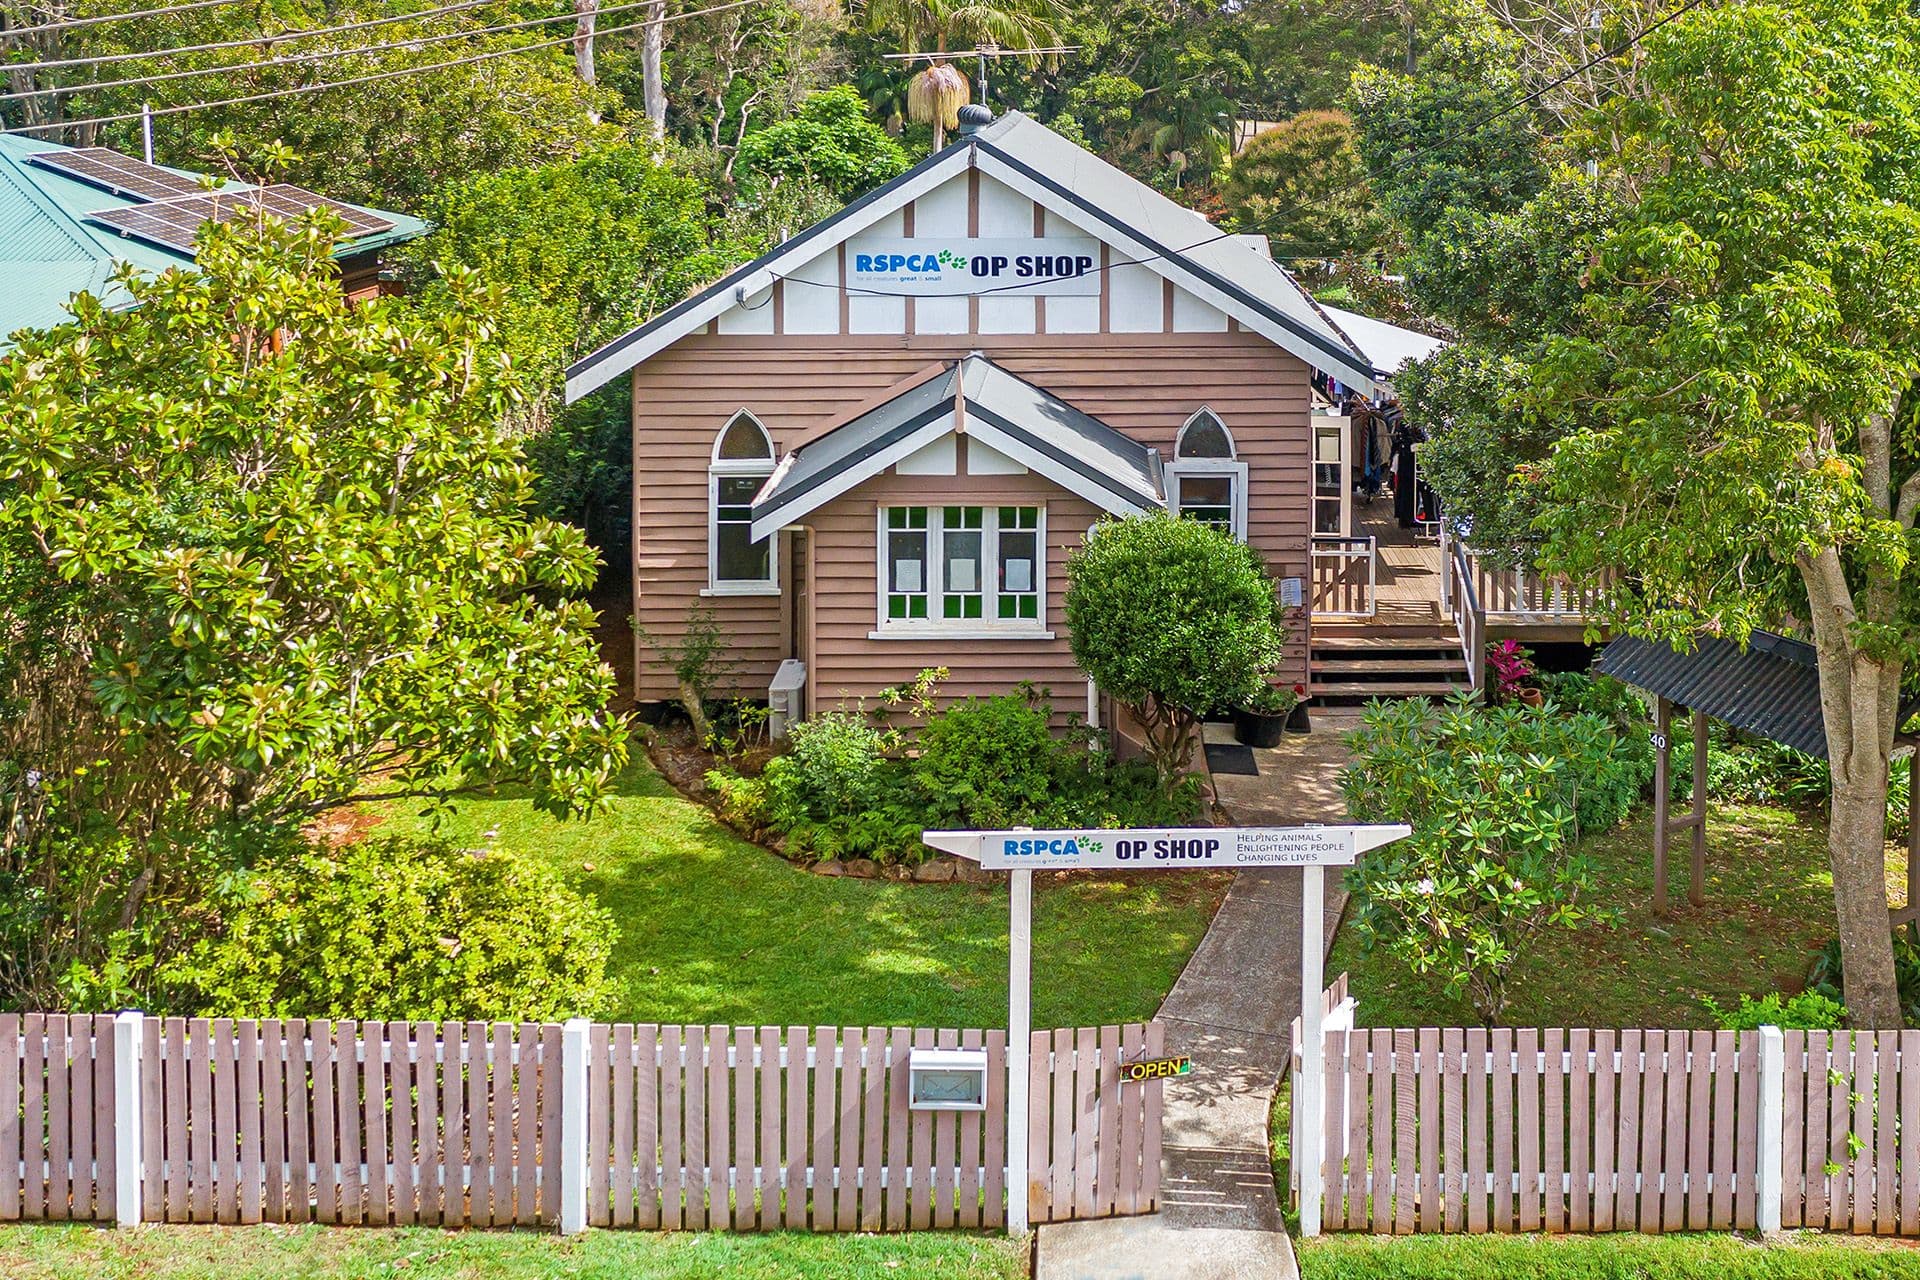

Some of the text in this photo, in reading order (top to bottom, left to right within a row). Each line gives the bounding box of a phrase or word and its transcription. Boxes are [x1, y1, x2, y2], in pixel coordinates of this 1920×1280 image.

[856, 254, 1093, 277] RSPCA OP SHOP
[1650, 734, 1666, 749] 40
[1237, 833, 1322, 842] HELPING ANIMALS
[1004, 839, 1220, 860] RSPCA OP SHOP
[1237, 843, 1345, 852] ENLIGHTENING PEOPLE
[1237, 853, 1318, 862] CHANGING LIVES
[1131, 1059, 1181, 1079] OPEN
